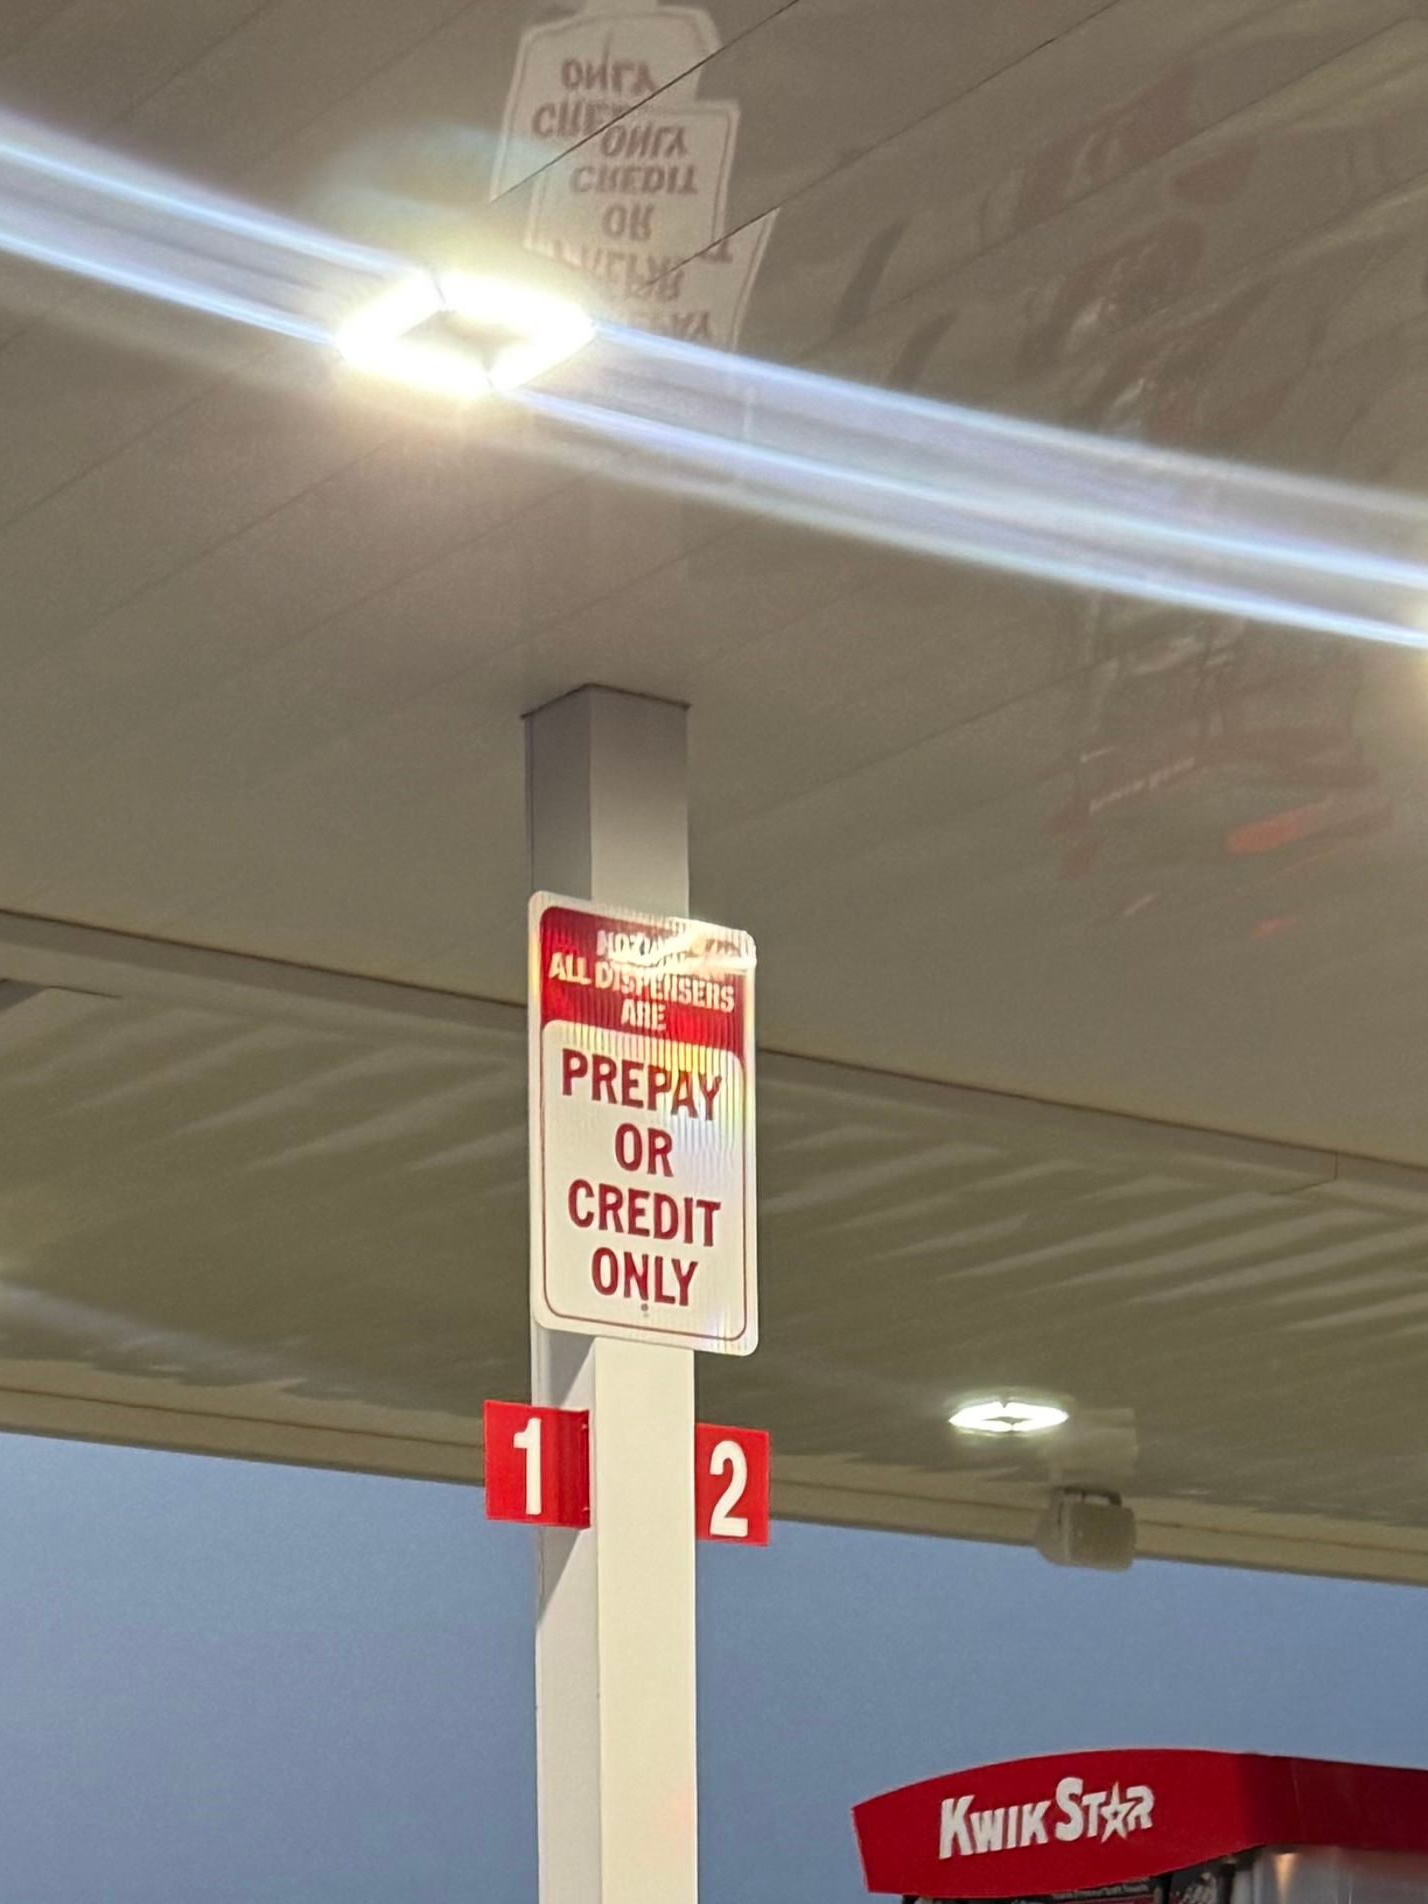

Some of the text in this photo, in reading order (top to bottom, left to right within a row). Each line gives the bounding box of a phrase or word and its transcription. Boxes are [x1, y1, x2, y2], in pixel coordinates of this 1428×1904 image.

[548, 951, 736, 1013] ALL DISPENSERS
[621, 999, 668, 1032] ARE
[562, 1048, 722, 1121] PREPAY
[615, 1122, 674, 1177] OR
[567, 1179, 721, 1247] CREDIT
[591, 1246, 699, 1307] ONLY
[513, 1417, 542, 1516] 1
[709, 1440, 749, 1537] 2
